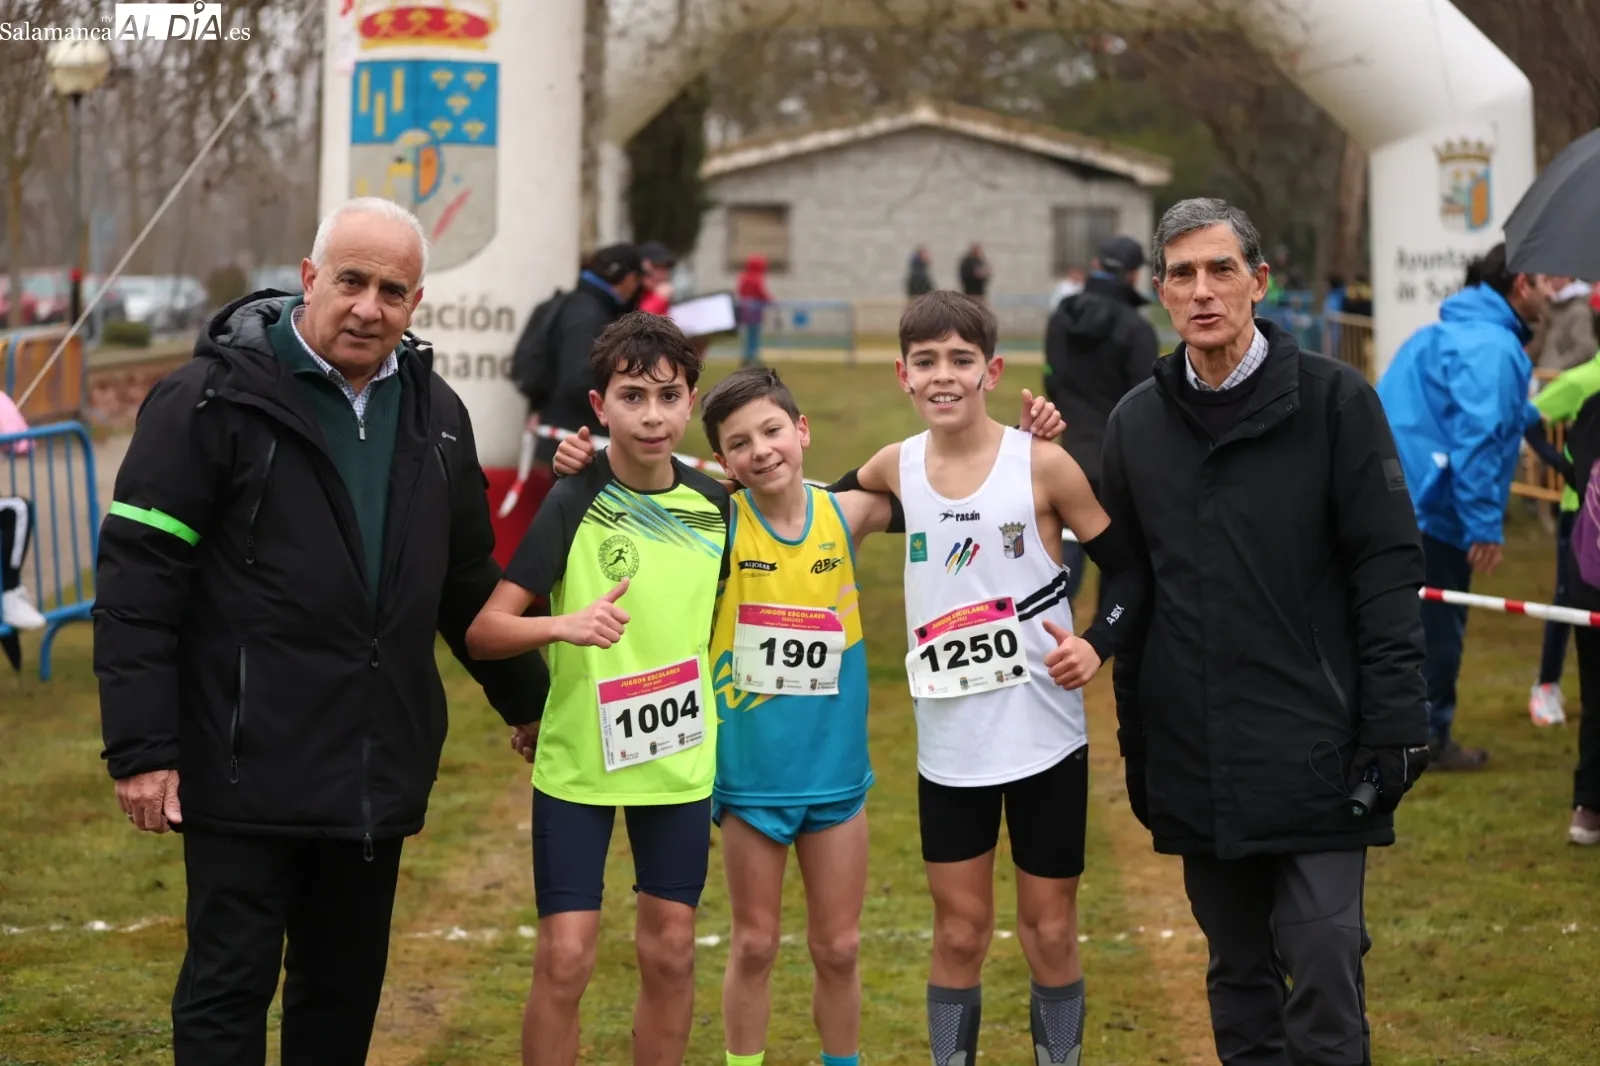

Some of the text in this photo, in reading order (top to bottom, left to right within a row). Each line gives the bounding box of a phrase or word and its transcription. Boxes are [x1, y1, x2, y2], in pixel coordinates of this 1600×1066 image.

[415, 293, 516, 333] ación
[955, 510, 980, 522] rasán
[759, 608, 826, 620] JUEGOS ESCOLARES
[931, 615, 952, 630] JUEGOS
[951, 604, 989, 619] ESCOLARES
[759, 637, 828, 669] 190
[920, 629, 1018, 672] 1250
[620, 677, 647, 688] JUEGOS
[647, 667, 681, 682] ESCOLARES
[615, 690, 700, 739] 1004
